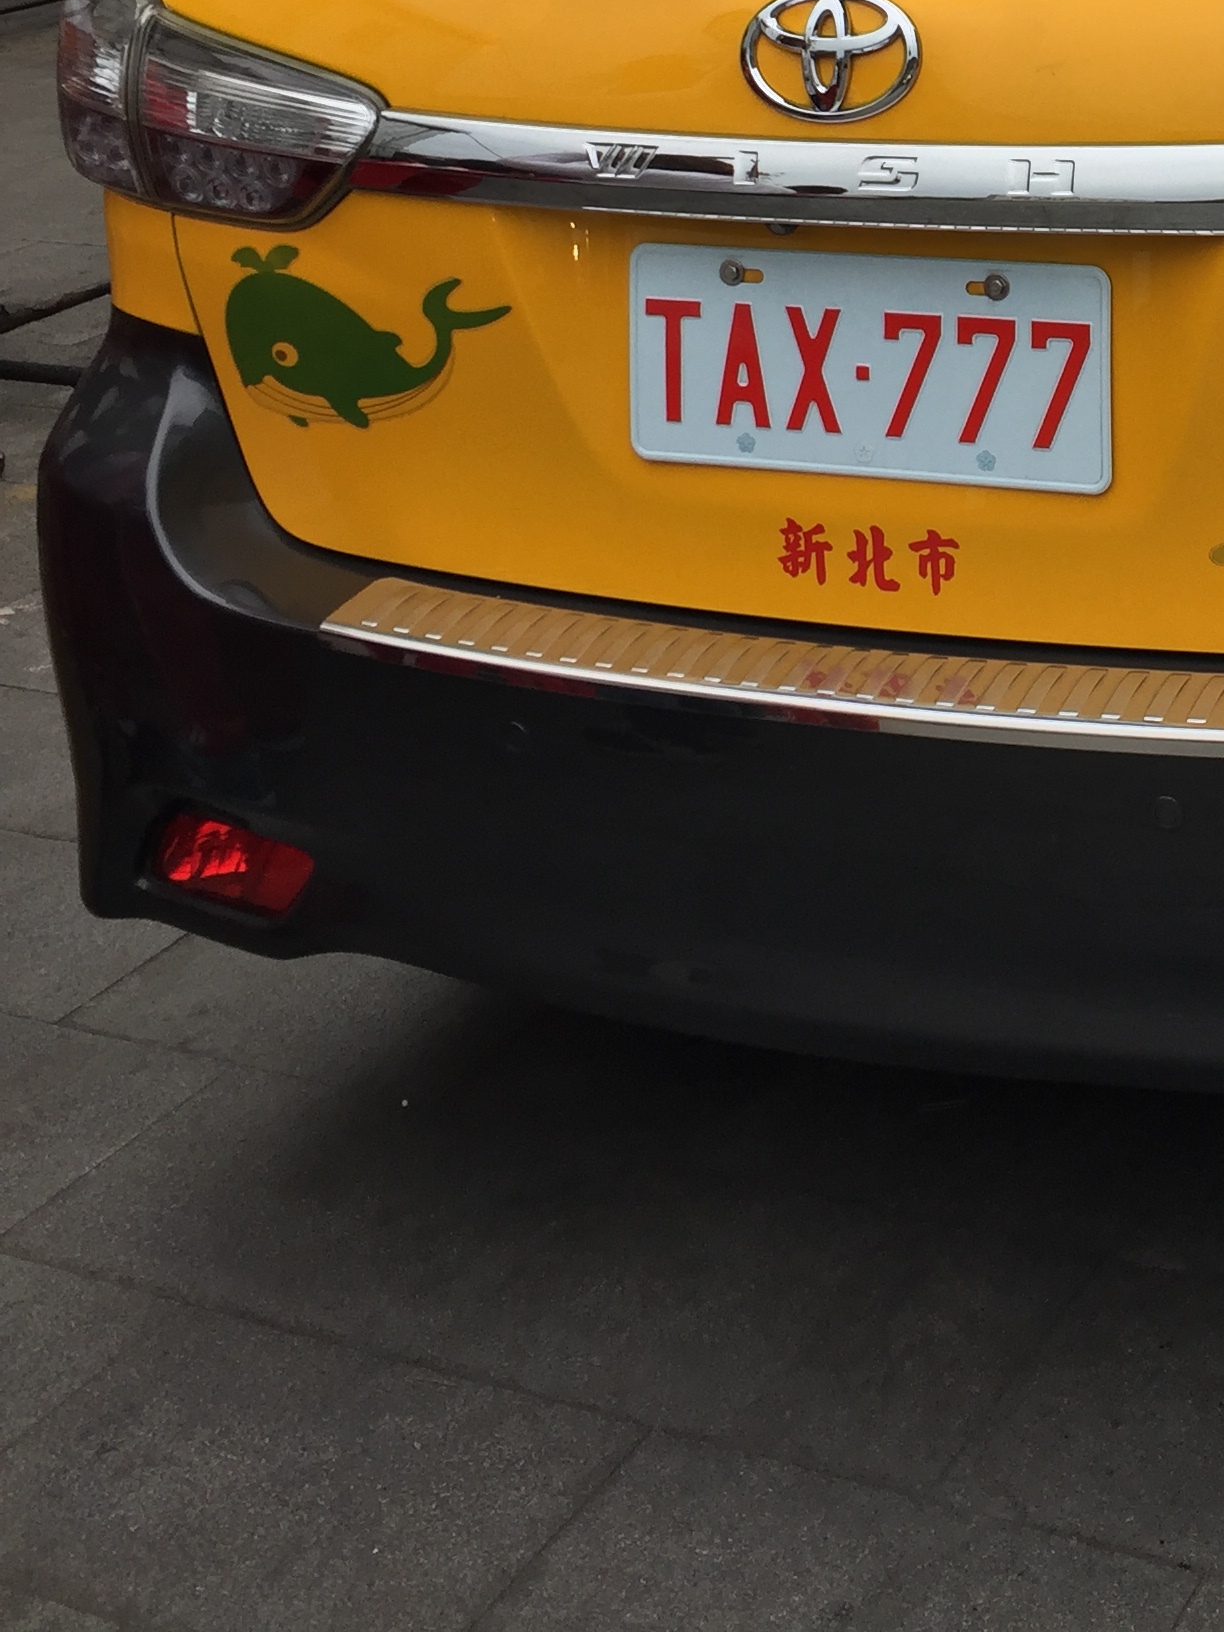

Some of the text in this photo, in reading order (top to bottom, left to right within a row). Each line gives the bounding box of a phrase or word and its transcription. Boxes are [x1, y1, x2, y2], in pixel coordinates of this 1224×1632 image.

[584, 141, 1076, 197] WISH
[778, 516, 962, 596] 新北市
